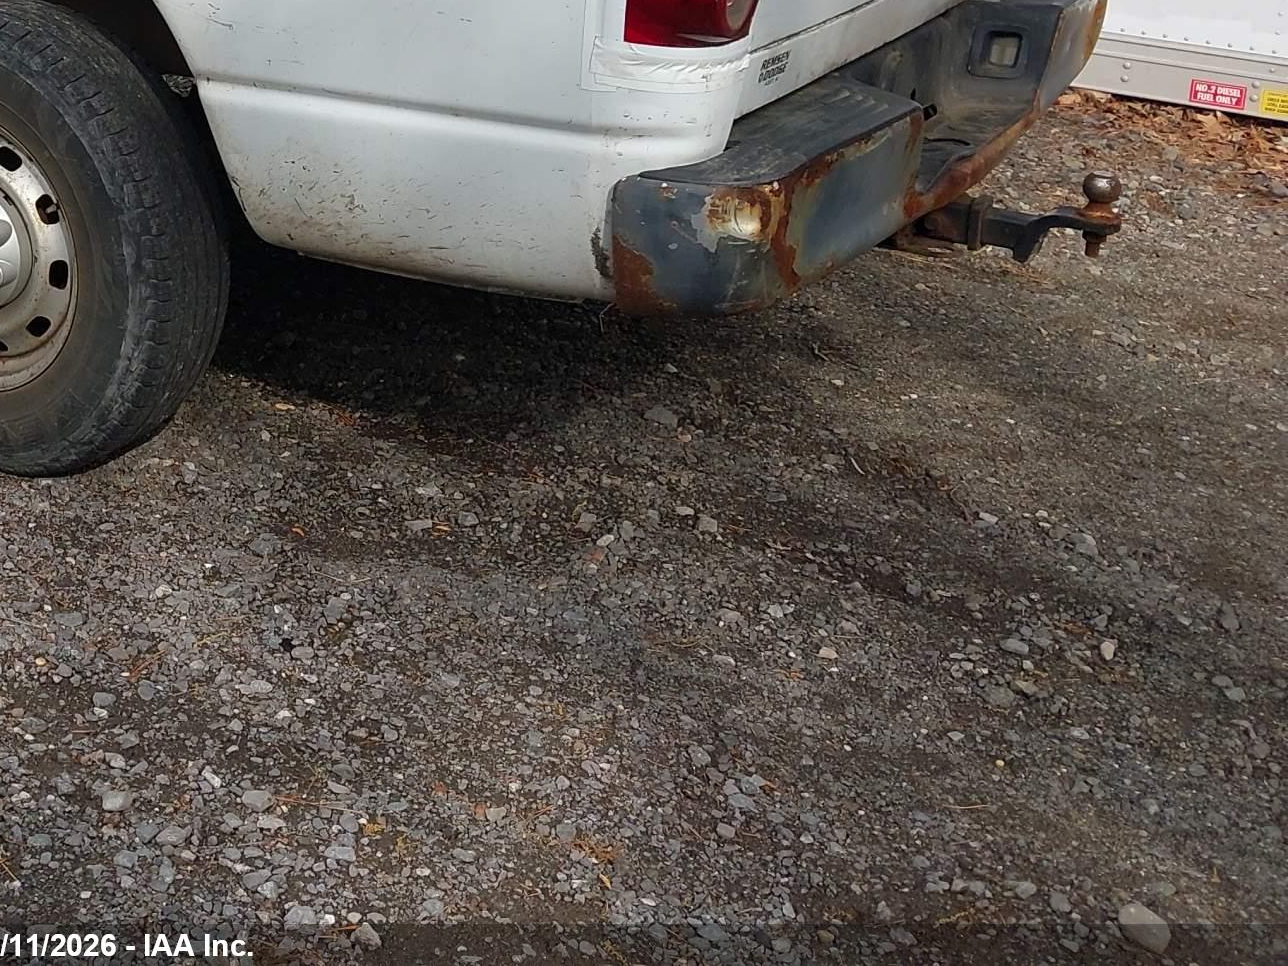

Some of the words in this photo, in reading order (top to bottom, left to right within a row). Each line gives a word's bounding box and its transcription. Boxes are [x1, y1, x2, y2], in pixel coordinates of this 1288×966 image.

[1216, 86, 1241, 98] DIESEL
[1197, 92, 1214, 102] FUEL
[1215, 95, 1238, 106] ONLY
